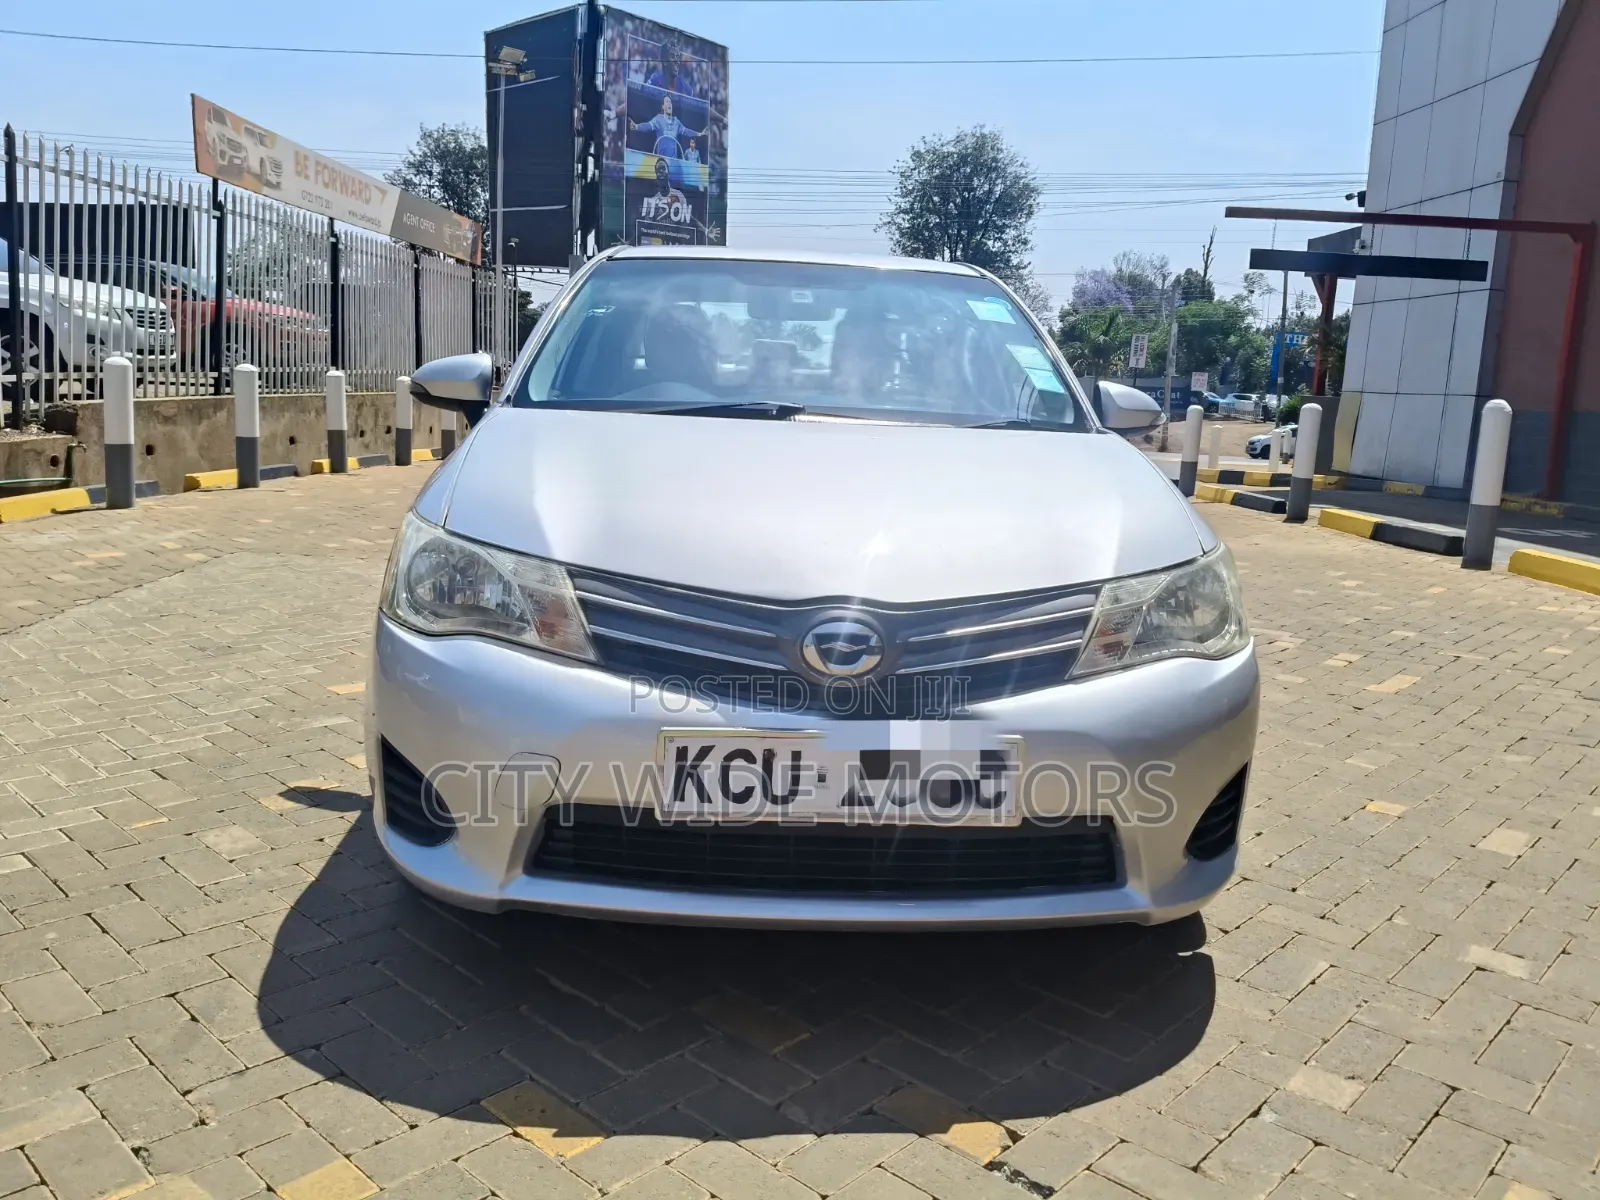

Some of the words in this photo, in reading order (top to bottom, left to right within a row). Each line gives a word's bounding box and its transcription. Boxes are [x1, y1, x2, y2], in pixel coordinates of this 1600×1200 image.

[295, 151, 310, 180] BE
[315, 160, 372, 205] FORWARD
[403, 212, 419, 227] AGENT
[420, 219, 436, 233] OFFICE
[673, 744, 802, 806] KCU
